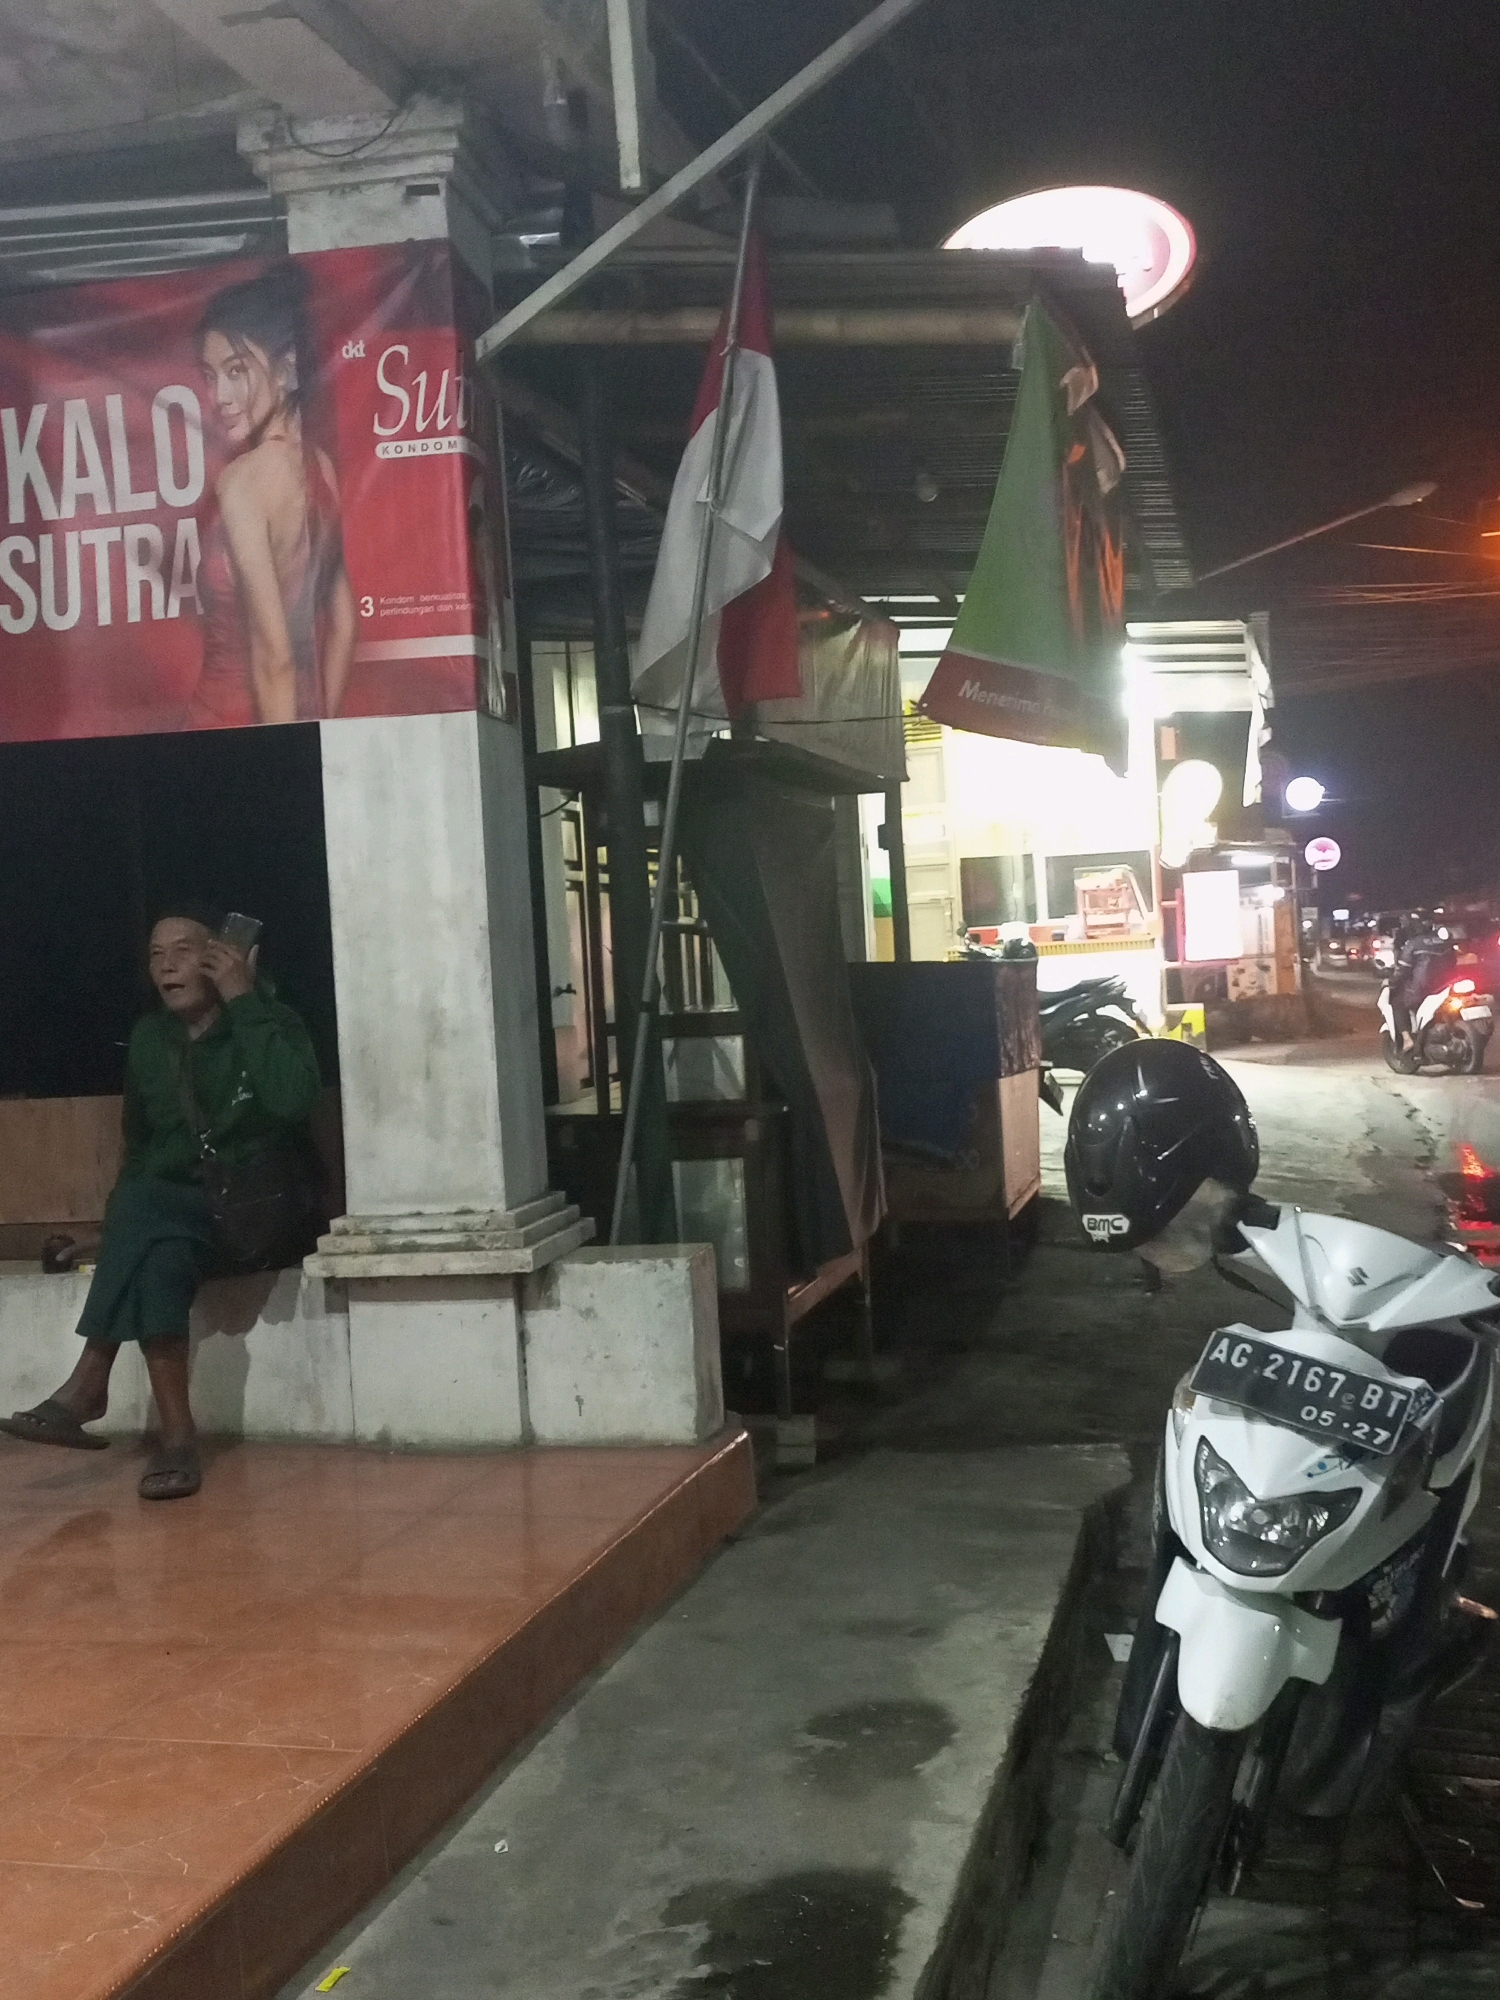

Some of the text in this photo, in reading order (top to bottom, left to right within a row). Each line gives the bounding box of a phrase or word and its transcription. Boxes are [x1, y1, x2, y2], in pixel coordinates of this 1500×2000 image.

[1, 384, 205, 525] KALO
[381, 440, 458, 455] KONDOM
[0, 517, 204, 635] SUTRA
[360, 595, 375, 618] 3
[1208, 1337, 1253, 1368] AG
[1262, 1353, 1347, 1399] 2167
[1360, 1383, 1408, 1419] BT
